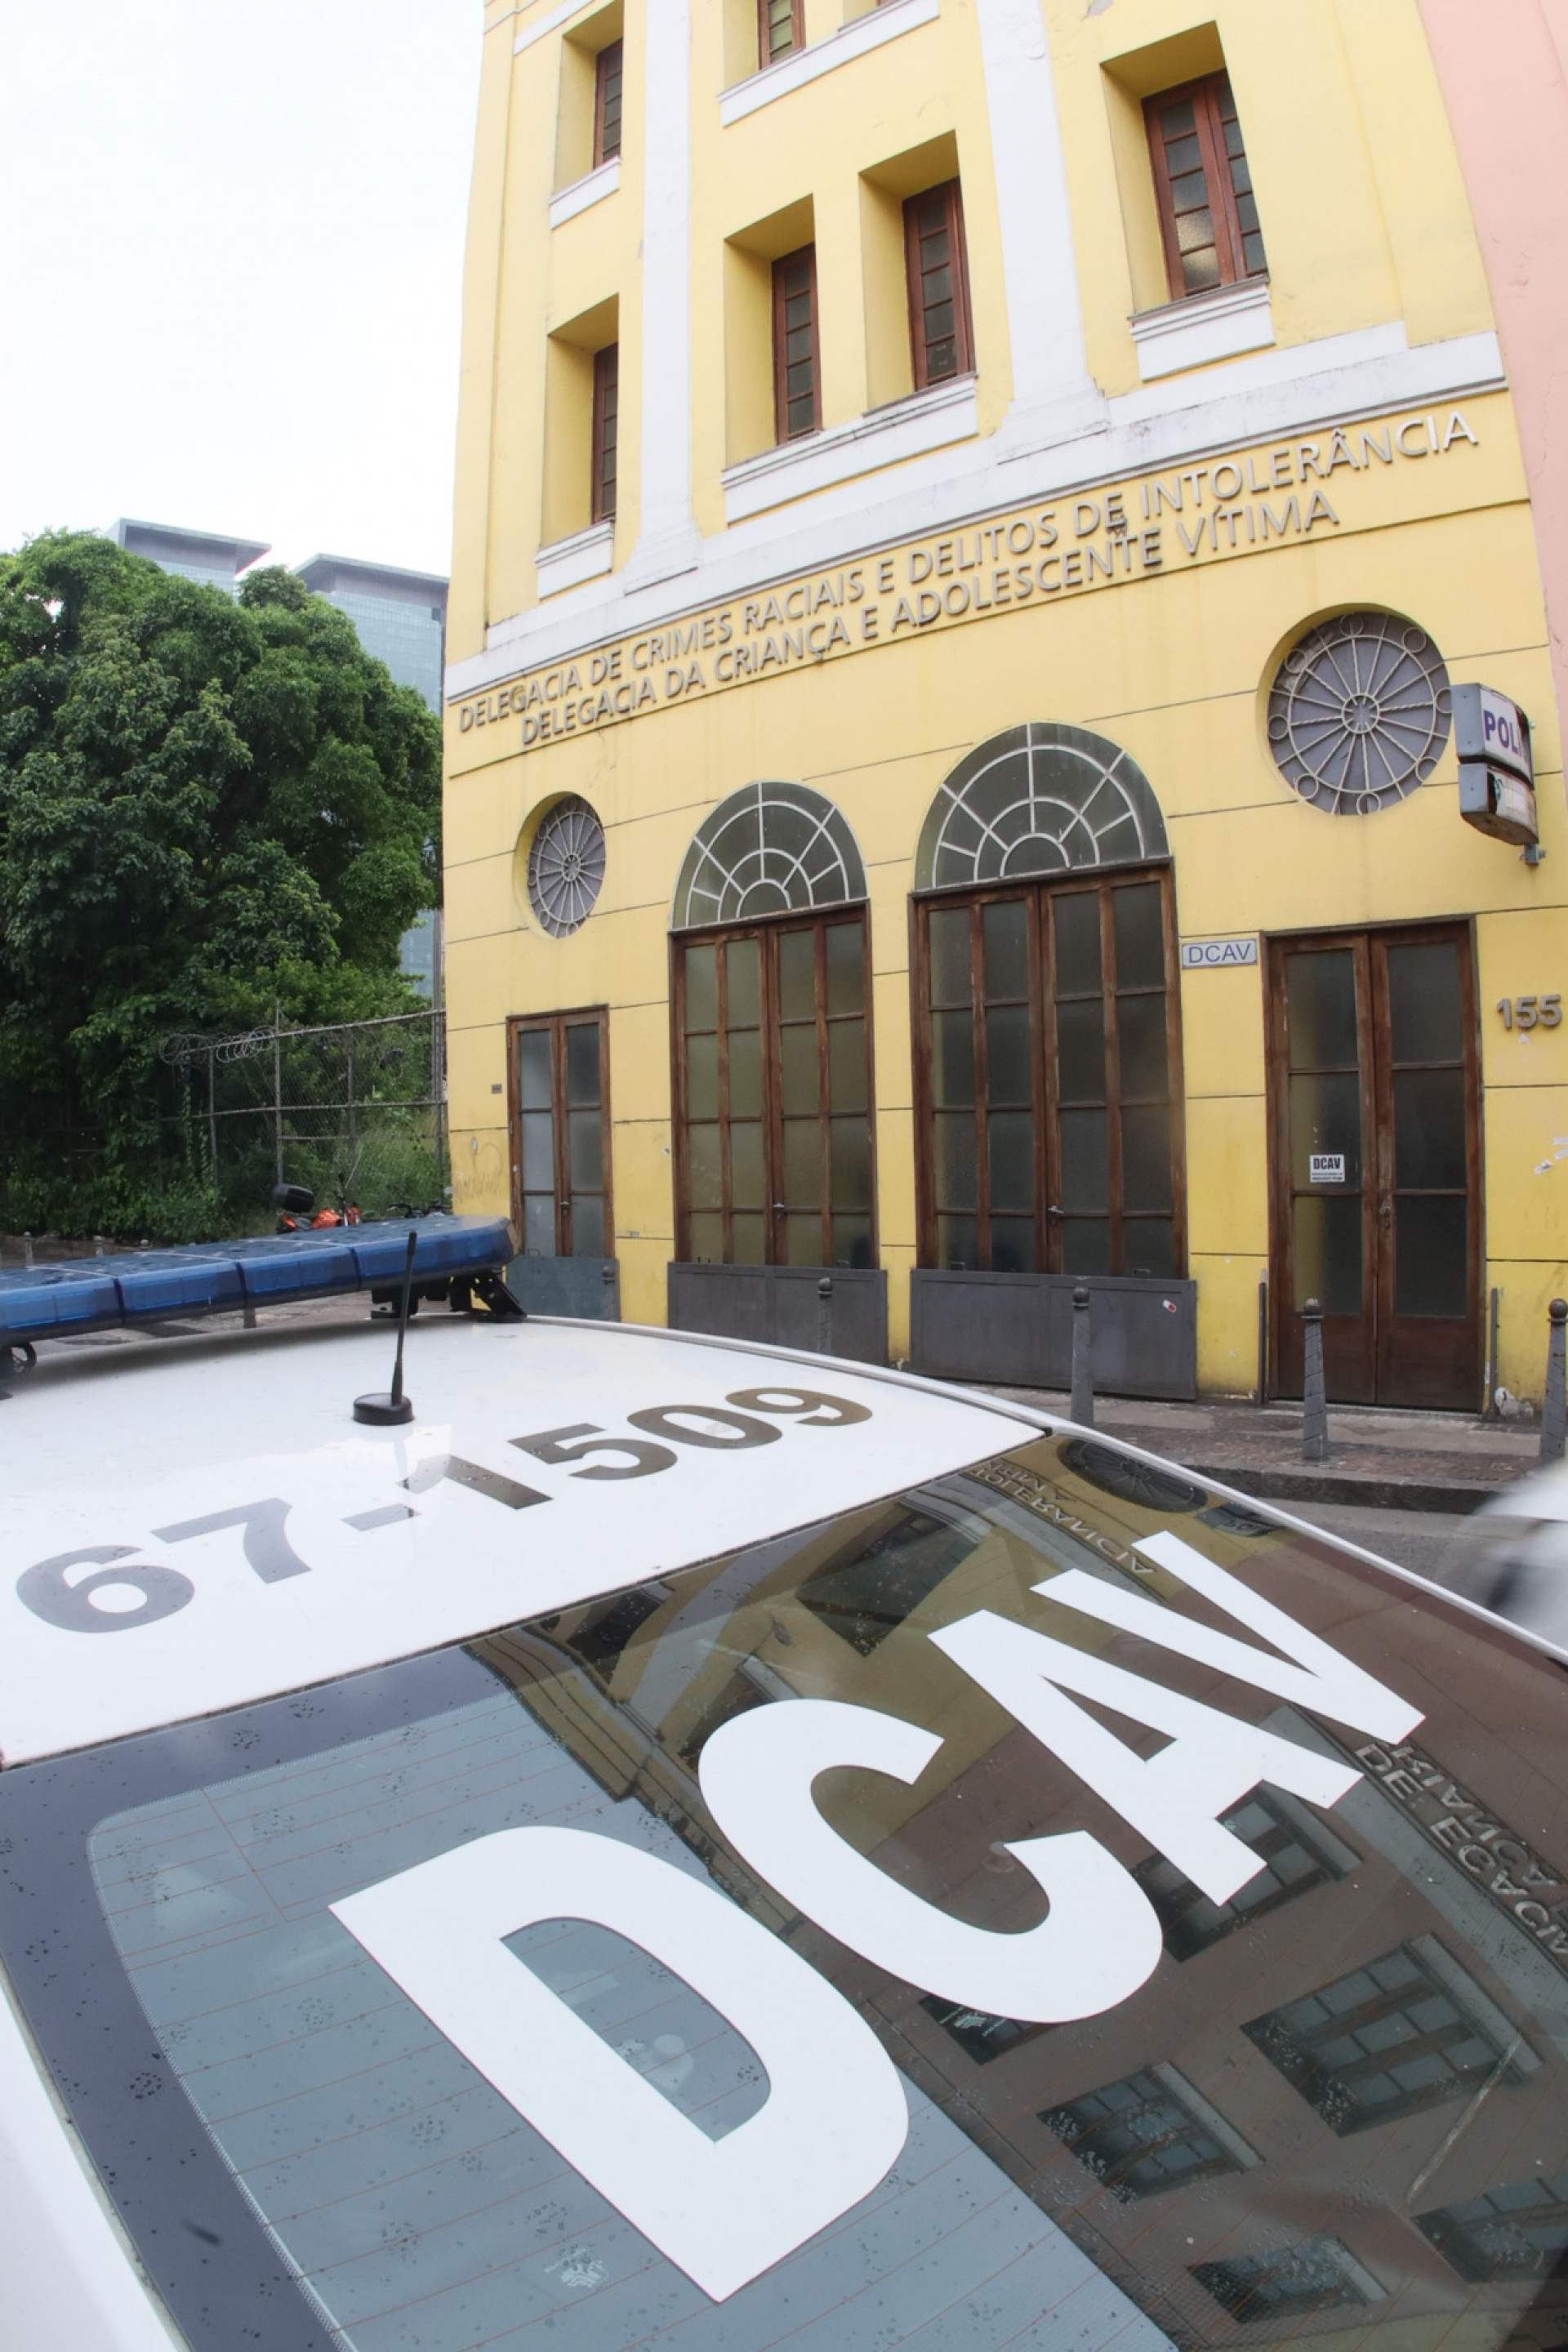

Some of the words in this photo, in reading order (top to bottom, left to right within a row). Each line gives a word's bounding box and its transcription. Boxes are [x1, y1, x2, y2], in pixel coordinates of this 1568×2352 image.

[459, 665, 583, 733] DELEGACIA
[590, 648, 621, 686] DE
[630, 611, 733, 670] CRIMES
[742, 568, 865, 635] RACIAIS
[876, 559, 895, 593] E
[908, 510, 1058, 584] DELITOS
[1073, 491, 1126, 538] DE
[1140, 410, 1480, 519] INTOLERÂNCIA
[521, 676, 657, 745] DELEGACIA
[665, 661, 706, 697] DA
[714, 616, 851, 681] CRIANÇA
[861, 605, 880, 639] E
[891, 534, 1138, 633] ADOLESCENTE
[1140, 528, 1163, 567] E
[1176, 489, 1340, 556] VÍTIMA
[1188, 943, 1251, 964] DCAV
[1496, 994, 1562, 1031] 155
[1312, 1156, 1341, 1170] DCAV
[16, 1387, 874, 1633] 67-1509
[328, 1530, 1427, 2303] DCAV
